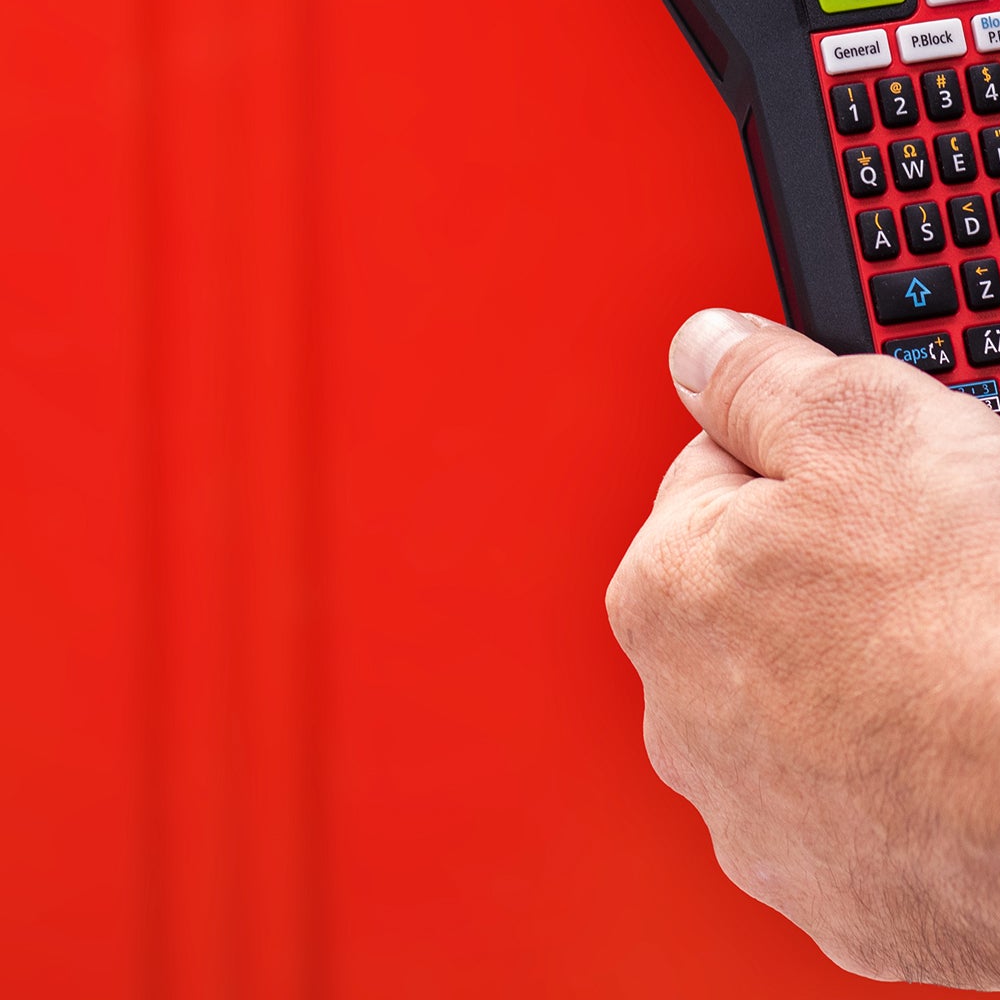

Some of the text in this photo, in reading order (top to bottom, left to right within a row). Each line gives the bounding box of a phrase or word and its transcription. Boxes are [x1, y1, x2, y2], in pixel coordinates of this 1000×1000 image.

[911, 30, 953, 48] P.Block
[834, 41, 881, 60] General
[848, 103, 859, 122] 1
[893, 96, 908, 116] 2
[939, 90, 953, 109] 3
[985, 82, 999, 101] 4
[860, 166, 878, 187] Q
[901, 159, 924, 180] W
[952, 153, 966, 172] E
[875, 230, 892, 250] A
[920, 222, 934, 242] S
[964, 217, 980, 236] D
[979, 279, 995, 300] Z
[894, 346, 928, 364] Caps
[939, 350, 950, 365] A
